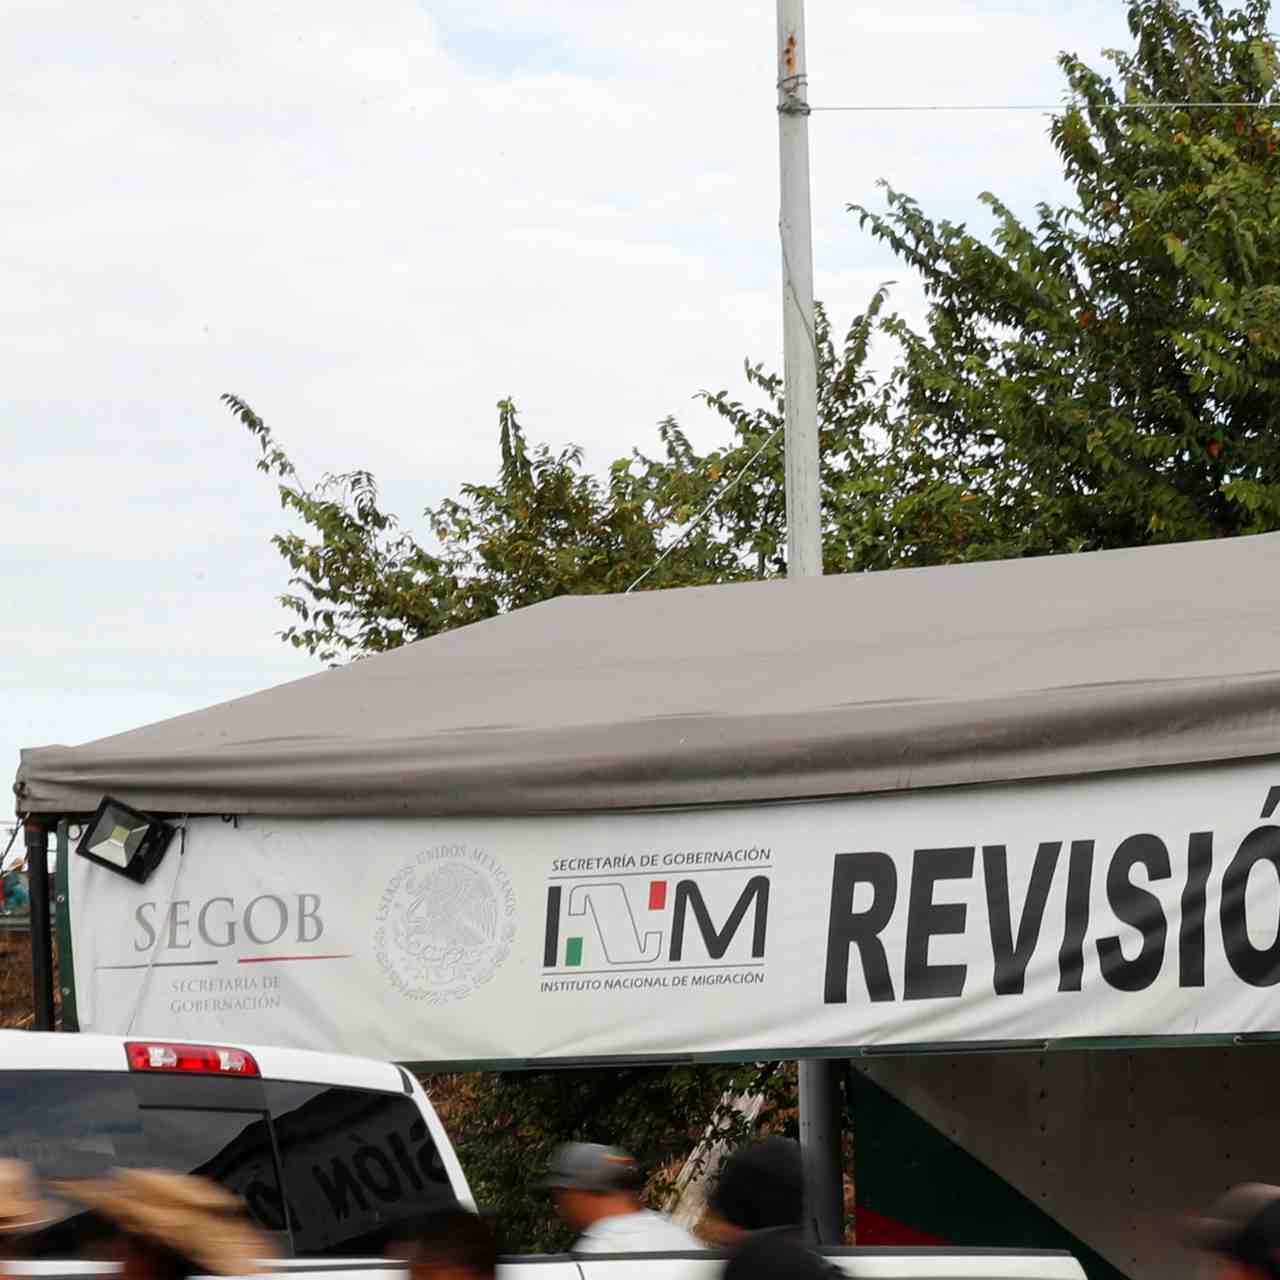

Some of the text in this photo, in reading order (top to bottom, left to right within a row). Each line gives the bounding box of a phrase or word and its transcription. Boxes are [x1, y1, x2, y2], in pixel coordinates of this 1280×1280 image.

[551, 845, 772, 872] SECRETARÍA DE GOBERNACIÓN
[134, 893, 325, 952] SEGOB
[262, 975, 281, 990] DE
[540, 972, 765, 993] INSTITUTO NACIONAL DE MIGRACIÓN
